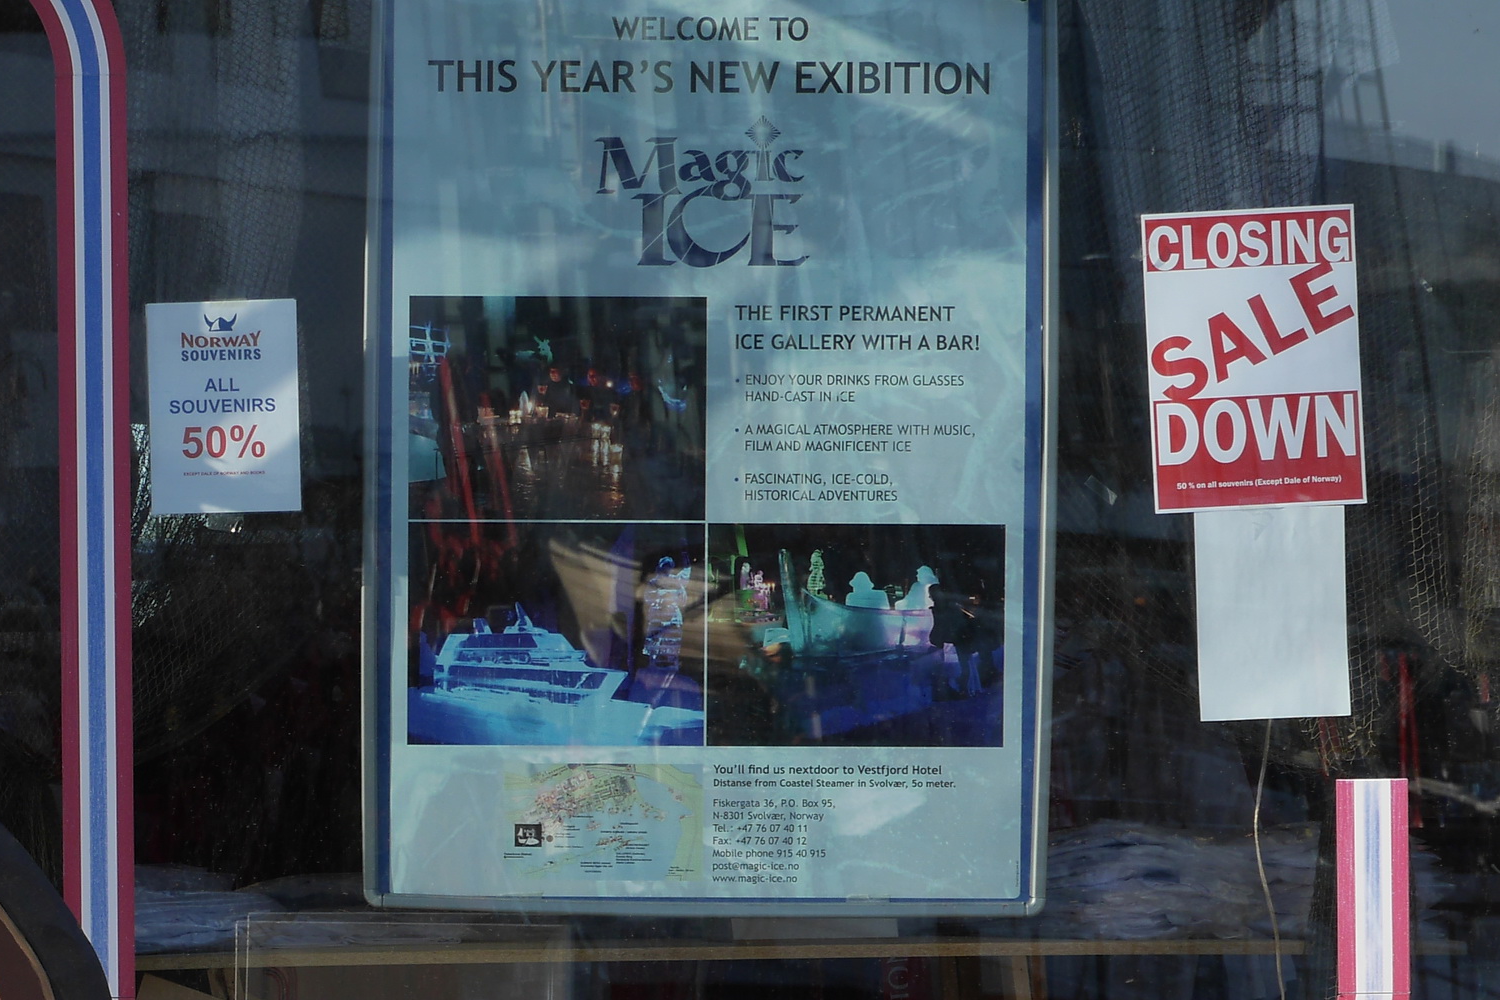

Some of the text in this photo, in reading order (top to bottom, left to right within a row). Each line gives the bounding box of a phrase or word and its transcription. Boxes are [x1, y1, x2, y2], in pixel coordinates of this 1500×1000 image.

[611, 16, 809, 42] WELCOME TO
[427, 59, 518, 93] THIS
[689, 61, 780, 94] NEW
[795, 61, 991, 96] EXIBITION
[594, 120, 805, 200] Magic
[631, 187, 810, 268] ICE
[1148, 217, 1351, 271] CLOSING
[735, 305, 955, 322] THE FIRST PERMANENT
[1151, 263, 1354, 400] SALE
[181, 330, 261, 348] NORWAY
[735, 334, 981, 351] ICE GALLERY WITH A BAR!
[181, 348, 261, 362] SOUVENIRS
[204, 378, 240, 393] ALL
[745, 374, 965, 387] ENJOY YOUR DRINKS FROM GLASSES
[745, 391, 856, 402] HAND-CAST IN ICE
[169, 398, 276, 415] SOUVENIRS
[745, 424, 976, 438] A MAGICAL ATMOSPHERE WITH MUSIC,
[1155, 393, 1357, 466] DOWN
[182, 424, 266, 459] 50%
[745, 440, 912, 452] FILM AND MAGNIFICENT ICE
[744, 473, 893, 487] FASCINATING, ICE-COLD,
[1176, 482, 1187, 490] 50
[1188, 482, 1195, 490] %
[1207, 480, 1217, 488] all
[1218, 479, 1253, 488] souvenirs
[1254, 477, 1283, 488] (Except
[1284, 476, 1301, 485] Dale
[1302, 476, 1311, 484] of
[1312, 474, 1342, 485] Norway)
[744, 490, 898, 502] HISTORICAL ADVENTURES
[748, 764, 770, 775] find
[773, 767, 786, 775] us
[788, 764, 839, 775] nextdoor
[842, 765, 855, 775] to
[858, 764, 909, 777] Vestfjord
[912, 765, 942, 775] Hotel
[713, 779, 752, 788] Distanse
[754, 779, 776, 788] from
[816, 779, 855, 788] Steamer
[857, 779, 867, 788] in
[869, 779, 908, 789] Svolvær,
[926, 779, 956, 788] meter.
[713, 799, 836, 809] Fiskergata 36, P.O. Box 95,
[713, 811, 824, 822] N-8301 Svolvær, Norway
[713, 824, 808, 833] Tel.: +47 76 07 40 11
[712, 836, 808, 846] Fax: +47 76 07 40 12
[712, 849, 827, 860] Mobile phone 915 40 915
[712, 861, 800, 872] post@magic-ice.no
[712, 874, 798, 884] www.magic-ice.no
